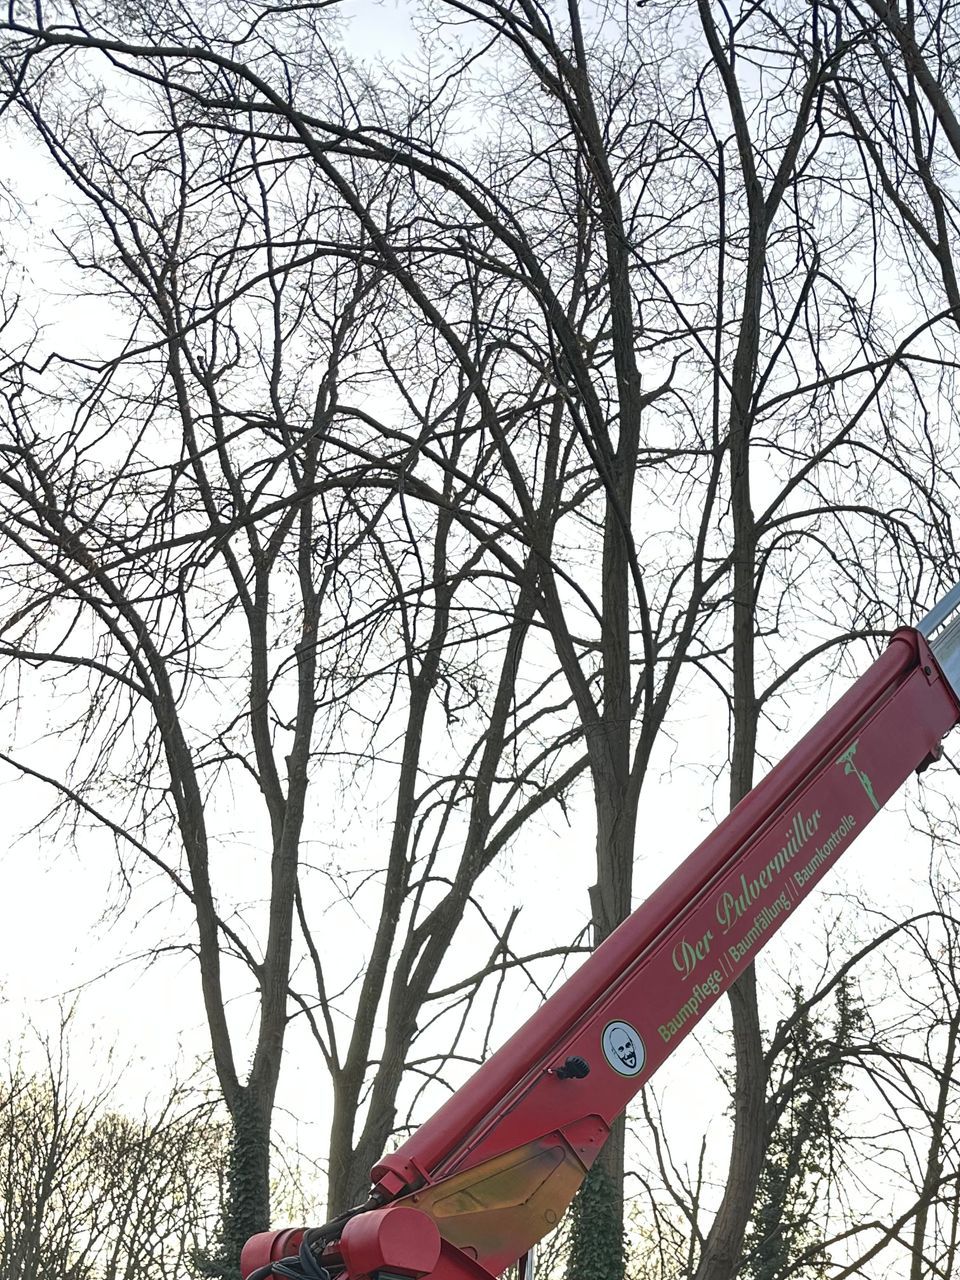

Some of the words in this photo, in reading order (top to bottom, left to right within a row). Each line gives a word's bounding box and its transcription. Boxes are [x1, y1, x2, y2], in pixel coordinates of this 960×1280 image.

[657, 969, 723, 1043] Baumpflege
[729, 892, 791, 963] Baumfällung
[793, 813, 857, 887] Baumkontrolle
[672, 926, 714, 981] Der
[715, 809, 822, 936] Pulvermüller
